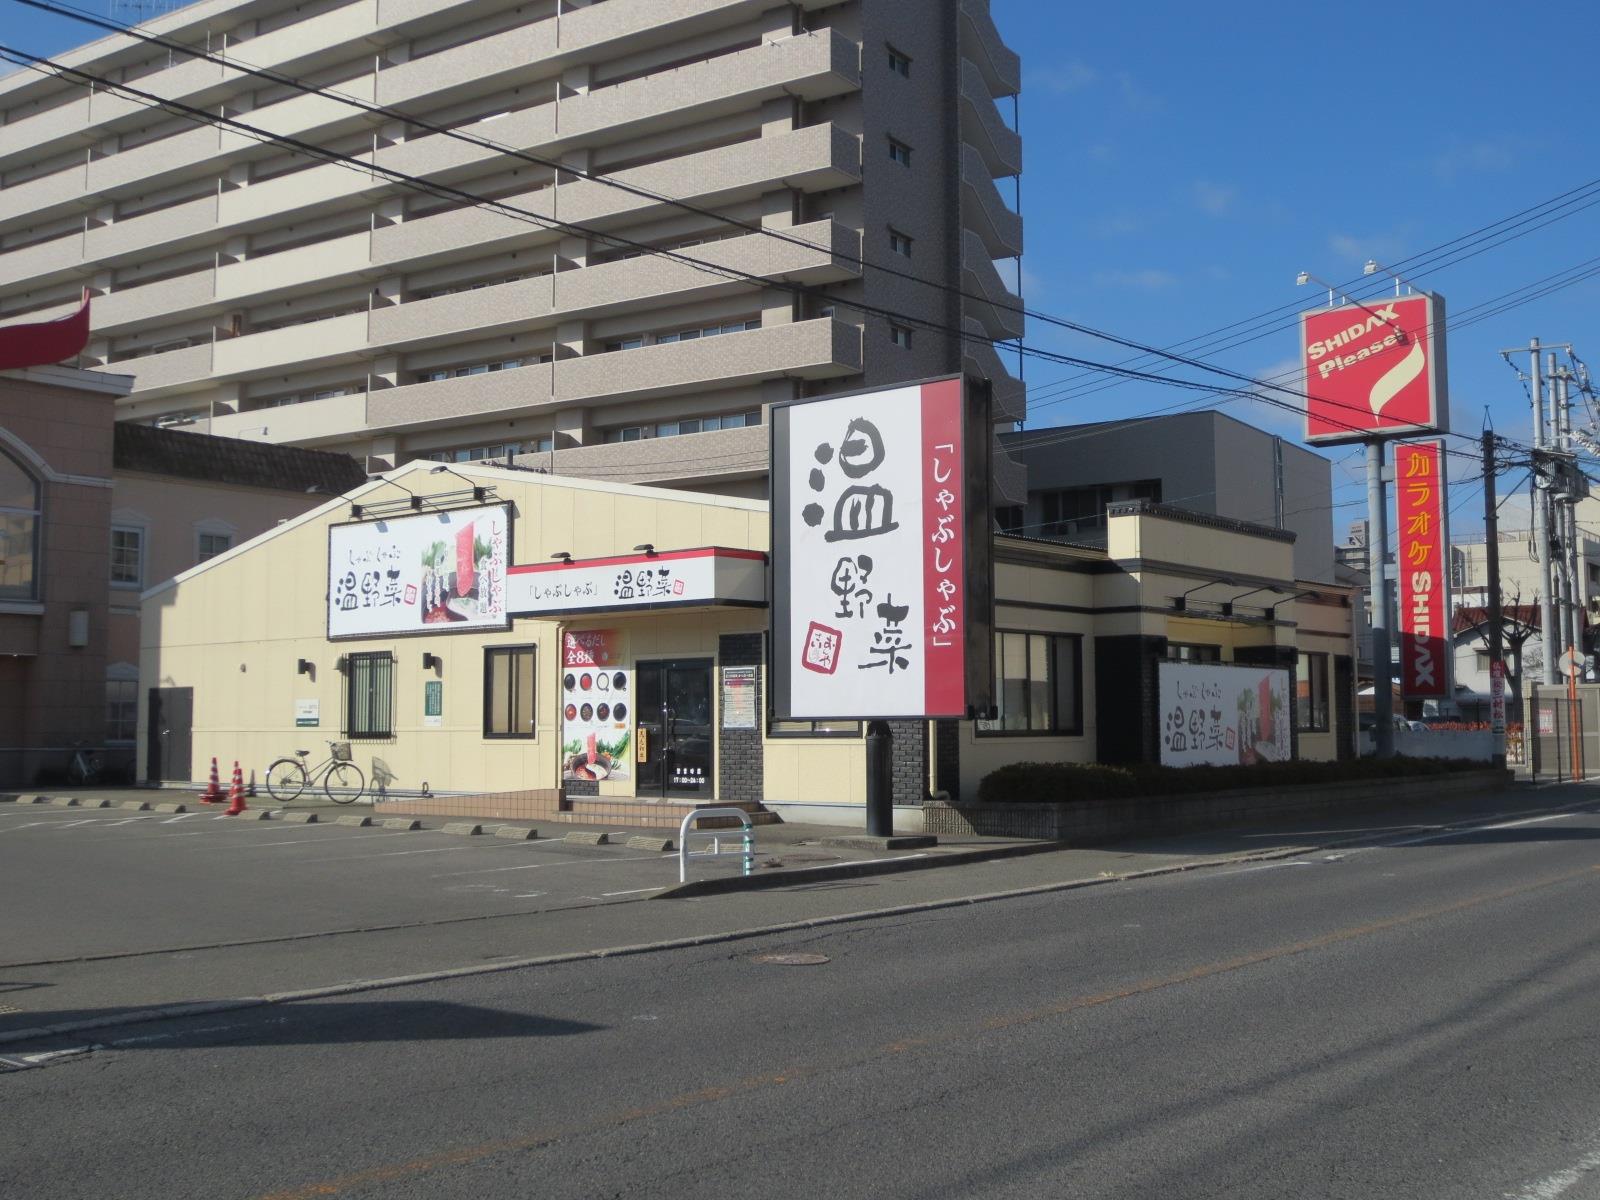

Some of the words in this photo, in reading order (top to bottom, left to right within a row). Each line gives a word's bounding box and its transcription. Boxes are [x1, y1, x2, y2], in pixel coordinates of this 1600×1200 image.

[1307, 303, 1400, 360] SHIDAX
[1405, 452, 1433, 566] カラオケ
[335, 564, 402, 612] 温野菜
[1411, 571, 1435, 688] SHIDAX
